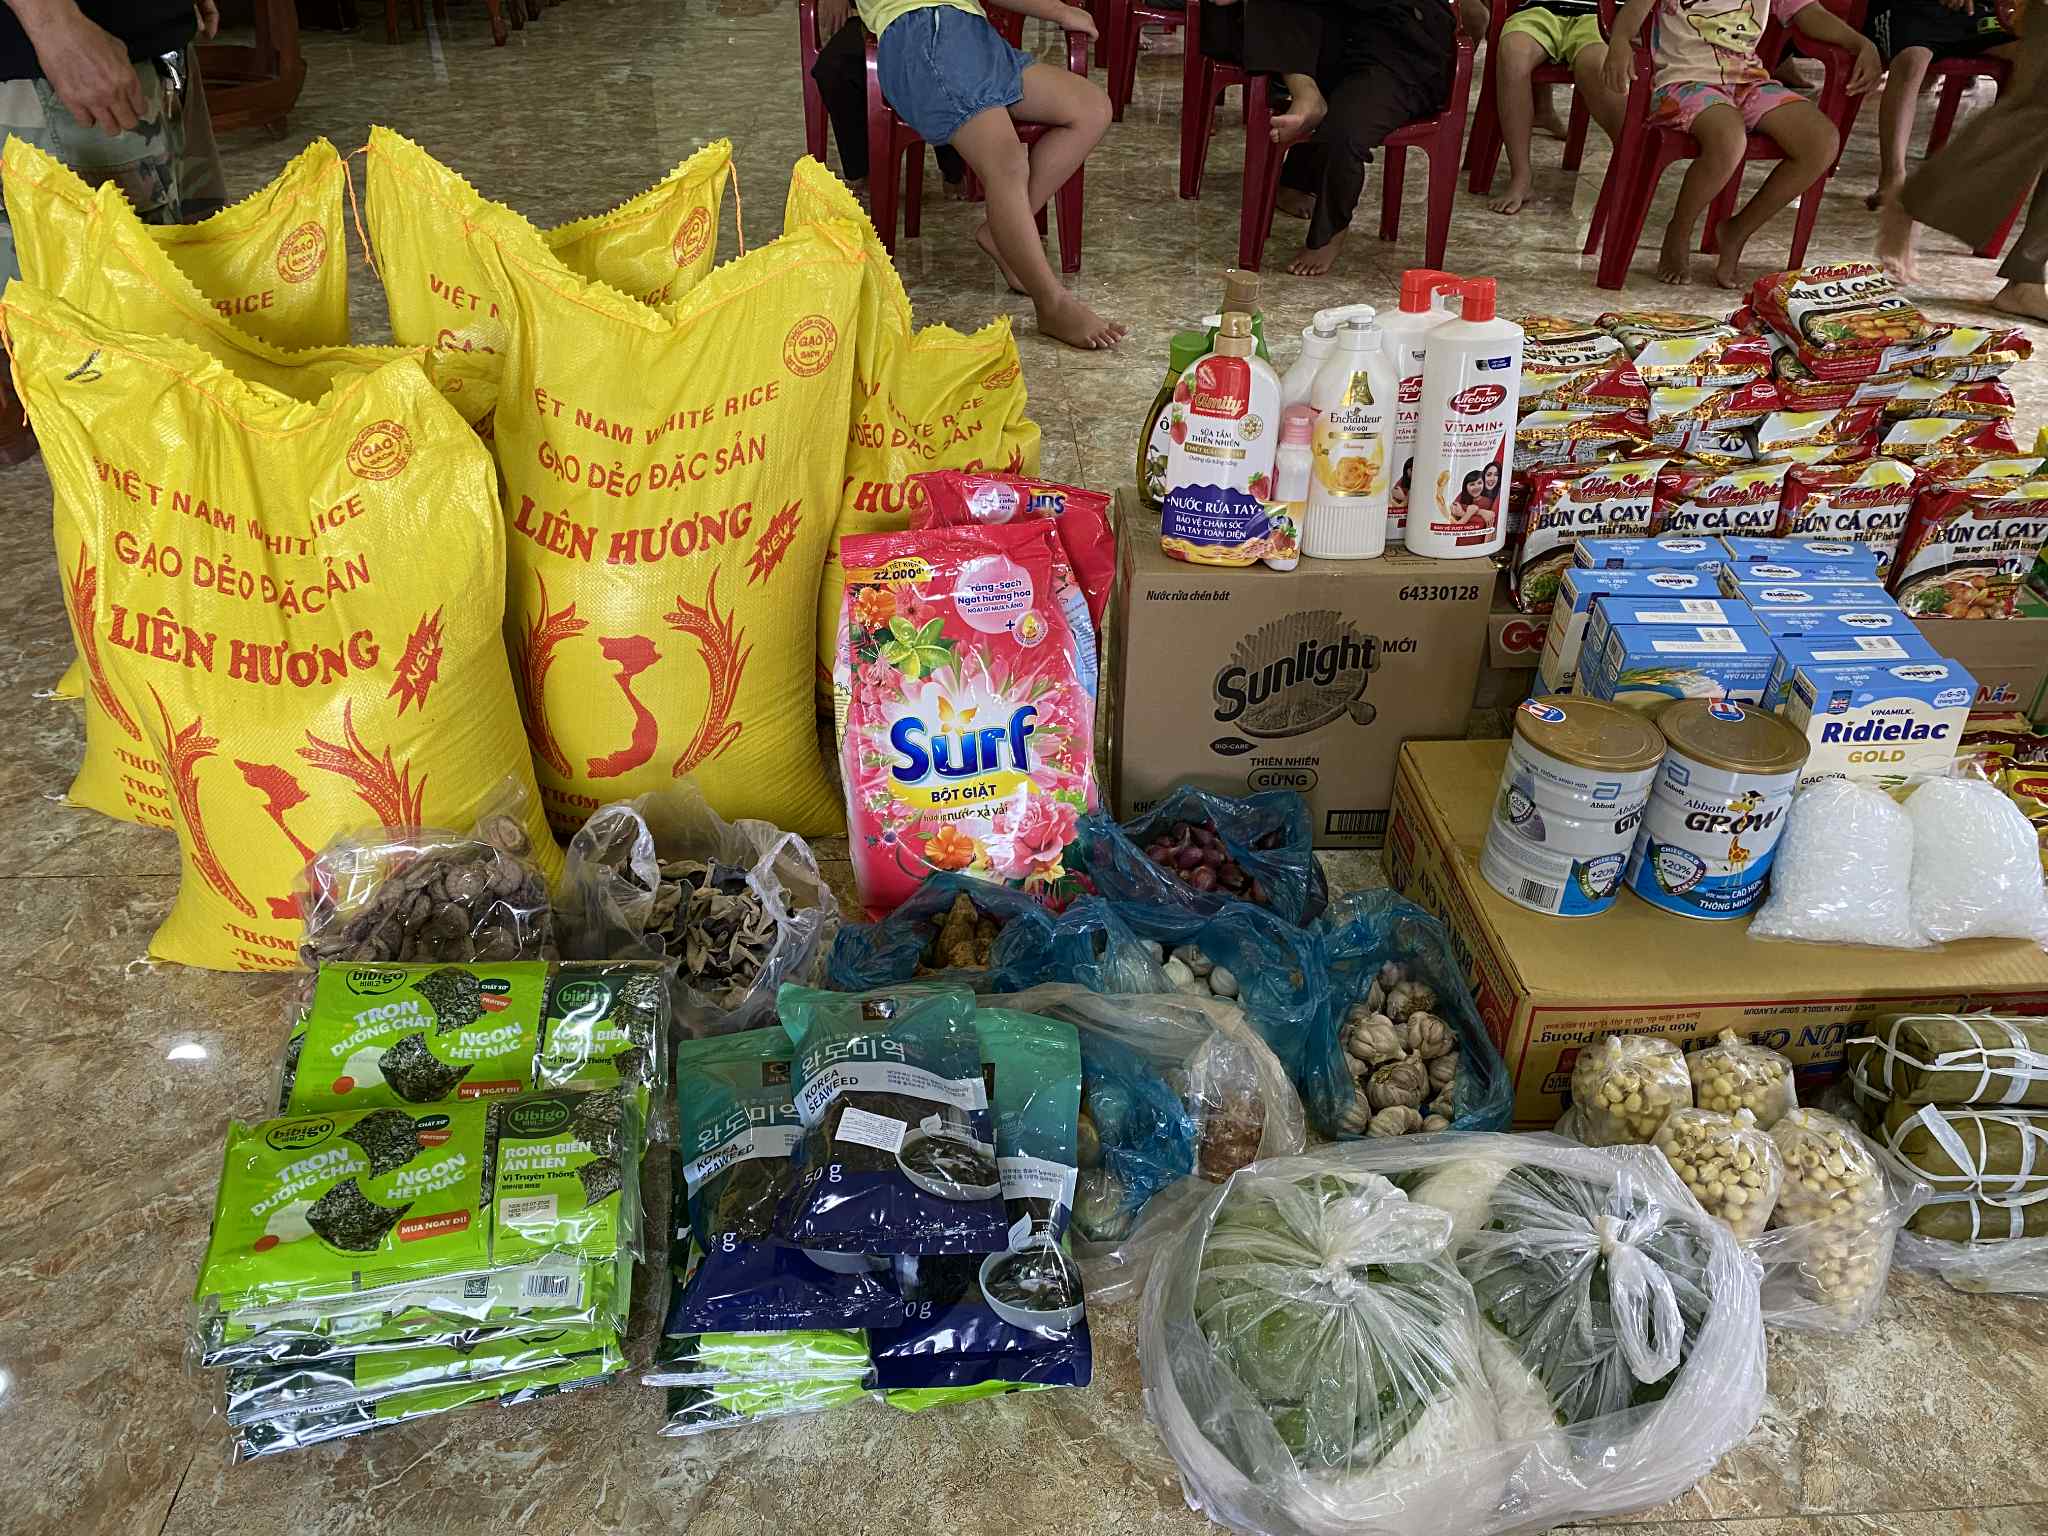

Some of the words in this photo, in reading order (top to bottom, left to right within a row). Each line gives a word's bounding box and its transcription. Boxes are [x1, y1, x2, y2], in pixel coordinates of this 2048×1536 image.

[429, 273, 480, 311] VIỆT
[1824, 281, 1849, 298] CÁ
[1852, 278, 1889, 292] CAY
[1454, 393, 1500, 407] Lifebuoy
[575, 407, 634, 445] NAM
[645, 402, 714, 445] WHITE
[724, 380, 780, 418] RICE
[1330, 411, 1382, 424] Enchanteur
[537, 440, 581, 484] GẠO
[587, 461, 641, 498] DẺO
[649, 452, 708, 492] ĐẶC
[715, 431, 766, 475] SẢN
[1025, 494, 1065, 514] Surf
[1170, 495, 1202, 513] NƯỚC
[1206, 499, 1229, 515] RỬA
[1234, 503, 1257, 514] TAY
[172, 490, 235, 534] NAM
[247, 519, 314, 556] WHIT
[310, 494, 364, 538] ICE
[1539, 508, 1574, 530] BÚN
[1578, 503, 1602, 525] CÁ
[1610, 505, 1650, 522] CAY
[1662, 511, 1699, 532] BÚN
[1703, 507, 1730, 529] CÁ
[1735, 510, 1775, 527] CAY
[1792, 515, 1830, 534] BÚN
[1835, 509, 1861, 531] CÁ
[1867, 511, 1907, 529] CAY
[513, 495, 598, 562] LIÊN
[607, 501, 753, 566] HƯƠNG
[1188, 525, 1201, 535] TAY
[1934, 524, 1974, 544] BÚN
[1977, 519, 2002, 541] CÁ
[2006, 523, 2047, 539] CAY
[114, 530, 182, 579] GẠO
[193, 554, 255, 600] DẺO
[260, 576, 326, 619] ĐẶC
[325, 553, 370, 600] ẢN
[1189, 590, 1212, 602] chén
[1213, 589, 1231, 602] bát
[1399, 585, 1480, 601] 64330128
[108, 604, 216, 673] LIÊN
[227, 629, 381, 688] HƯƠNG
[1382, 638, 1418, 653] MỚI
[1213, 635, 1377, 722] Sunlight
[1871, 709, 1912, 717] VINAMILK
[1821, 719, 1951, 745] Ridielac
[890, 705, 1039, 783] Surf
[1250, 756, 1282, 767] THIÊN
[1284, 756, 1320, 767] NHIÊN
[1848, 749, 1907, 765] GOLD
[1257, 771, 1308, 787] GỪNG
[1664, 780, 1685, 796] Abbott
[931, 788, 959, 803] BỘT
[963, 783, 997, 800] GIẶT
[1590, 801, 1616, 809] Abbott
[1683, 798, 1727, 814] Abbott
[1661, 858, 1692, 876] +20%
[1732, 887, 1746, 899] CAO
[1699, 898, 1731, 911] THÔNG
[353, 970, 403, 983] bibigo
[458, 1021, 523, 1047] NGON
[1634, 1023, 1665, 1036] ngon
[1670, 1022, 1698, 1034] Món
[1541, 1031, 1594, 1045] Phòng
[801, 1038, 907, 1081] 완도미역
[803, 1069, 839, 1101] KOREA
[808, 1076, 859, 1115] SEAWEED
[514, 1107, 566, 1122] bibigo
[274, 1121, 331, 1139] bibigo
[505, 1145, 551, 1158] RONG
[396, 1153, 467, 1186] NGON
[829, 1164, 843, 1183] g
[401, 1223, 423, 1234] MUA
[425, 1219, 451, 1231] NGAY
